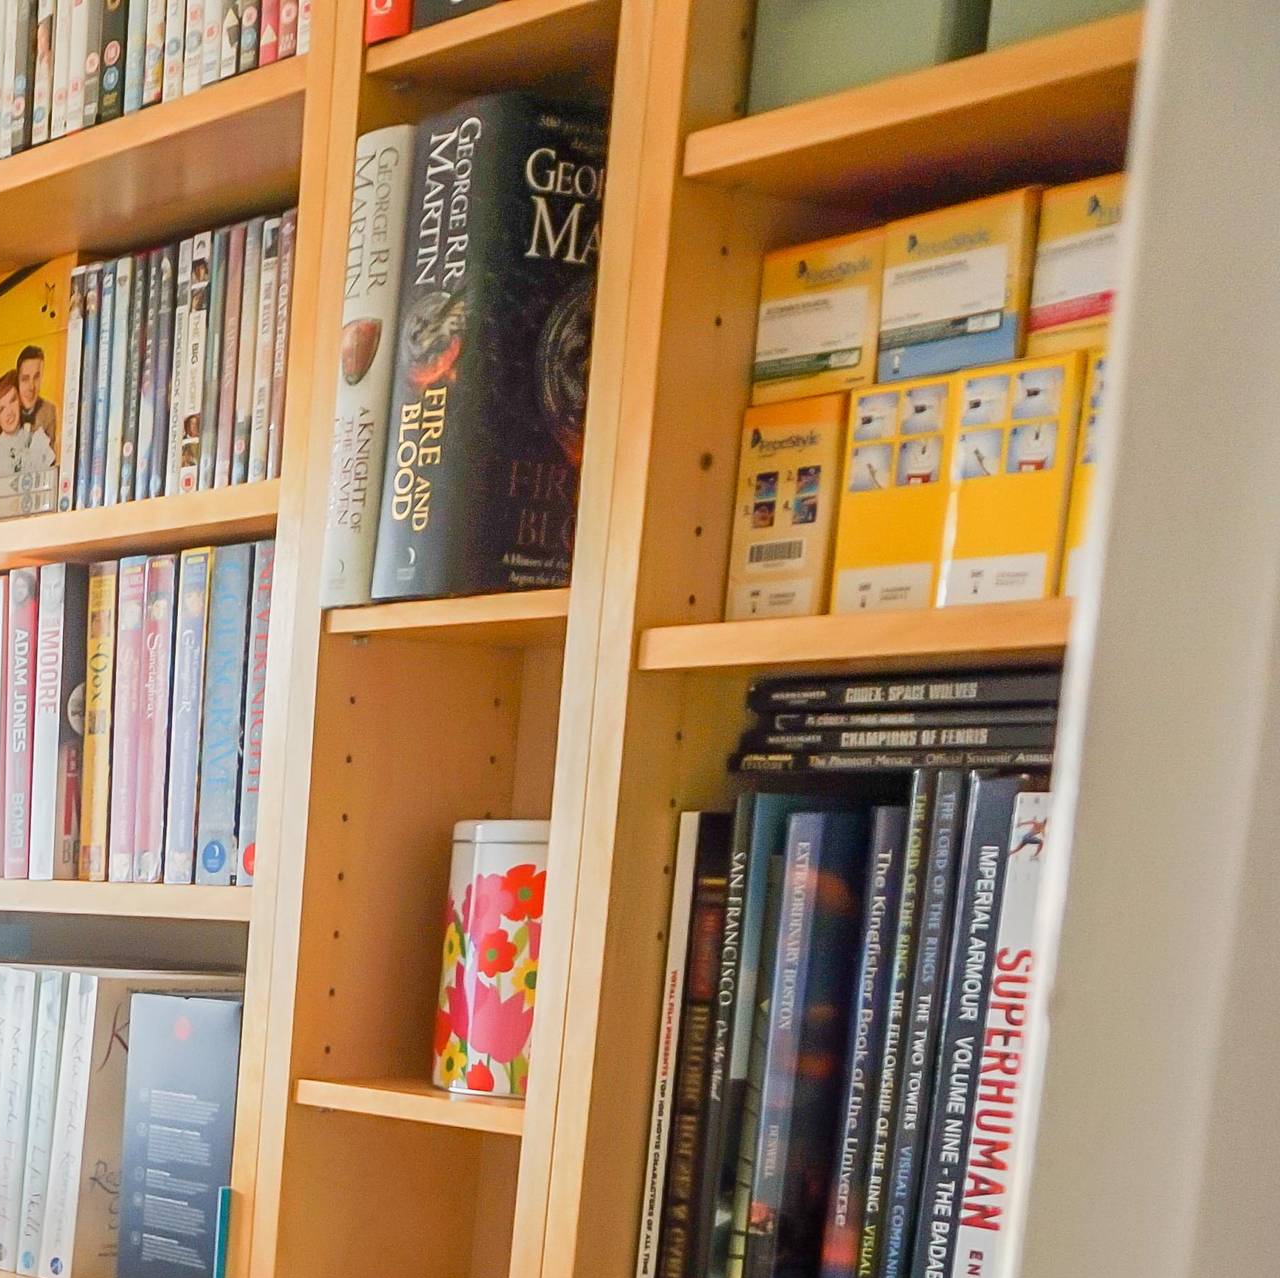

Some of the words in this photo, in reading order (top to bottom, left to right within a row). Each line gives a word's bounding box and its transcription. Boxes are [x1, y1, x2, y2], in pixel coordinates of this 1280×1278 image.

[370, 146, 400, 242] GEORGE
[446, 117, 483, 230] GEORGE
[343, 152, 375, 300] MARTIN
[413, 127, 459, 284] MARTIN
[172, 312, 184, 396] BROKEBACK
[190, 342, 199, 364] BIG
[415, 386, 449, 466] FIRE
[352, 422, 373, 507] KNIGHT
[389, 402, 423, 520] BLOOD
[409, 475, 433, 531] AND
[13, 629, 28, 685] ADAM
[12, 690, 27, 752] JONES
[841, 730, 918, 748] CHAMPIONS
[921, 729, 937, 746] OF
[727, 852, 745, 892] SAN
[874, 849, 892, 888] The
[966, 845, 1001, 934] IMPERIAL
[717, 896, 742, 1006] FRANCISCO
[860, 896, 887, 999] Kingfisher
[889, 991, 905, 1016] THE
[956, 936, 992, 1020] ARMOUR
[854, 1009, 873, 1060] Book
[914, 994, 932, 1022] THE
[875, 1024, 903, 1111] FELLOWSHIP
[909, 1029, 928, 1065] TWO
[942, 1036, 977, 1112] VOLUME
[851, 1068, 866, 1089] of
[900, 1071, 923, 1129] TOWERS
[958, 948, 1032, 1231] SUPERHUMAN
[846, 1097, 863, 1129] the
[875, 1117, 889, 1136] OF
[936, 1119, 965, 1162] NINE
[833, 1137, 858, 1226] Universe
[871, 1143, 887, 1169] THE
[893, 1145, 913, 1198] VISUAL
[865, 1176, 883, 1212] RING
[930, 1181, 957, 1216] THE
[858, 1224, 876, 1274] VISUAL
